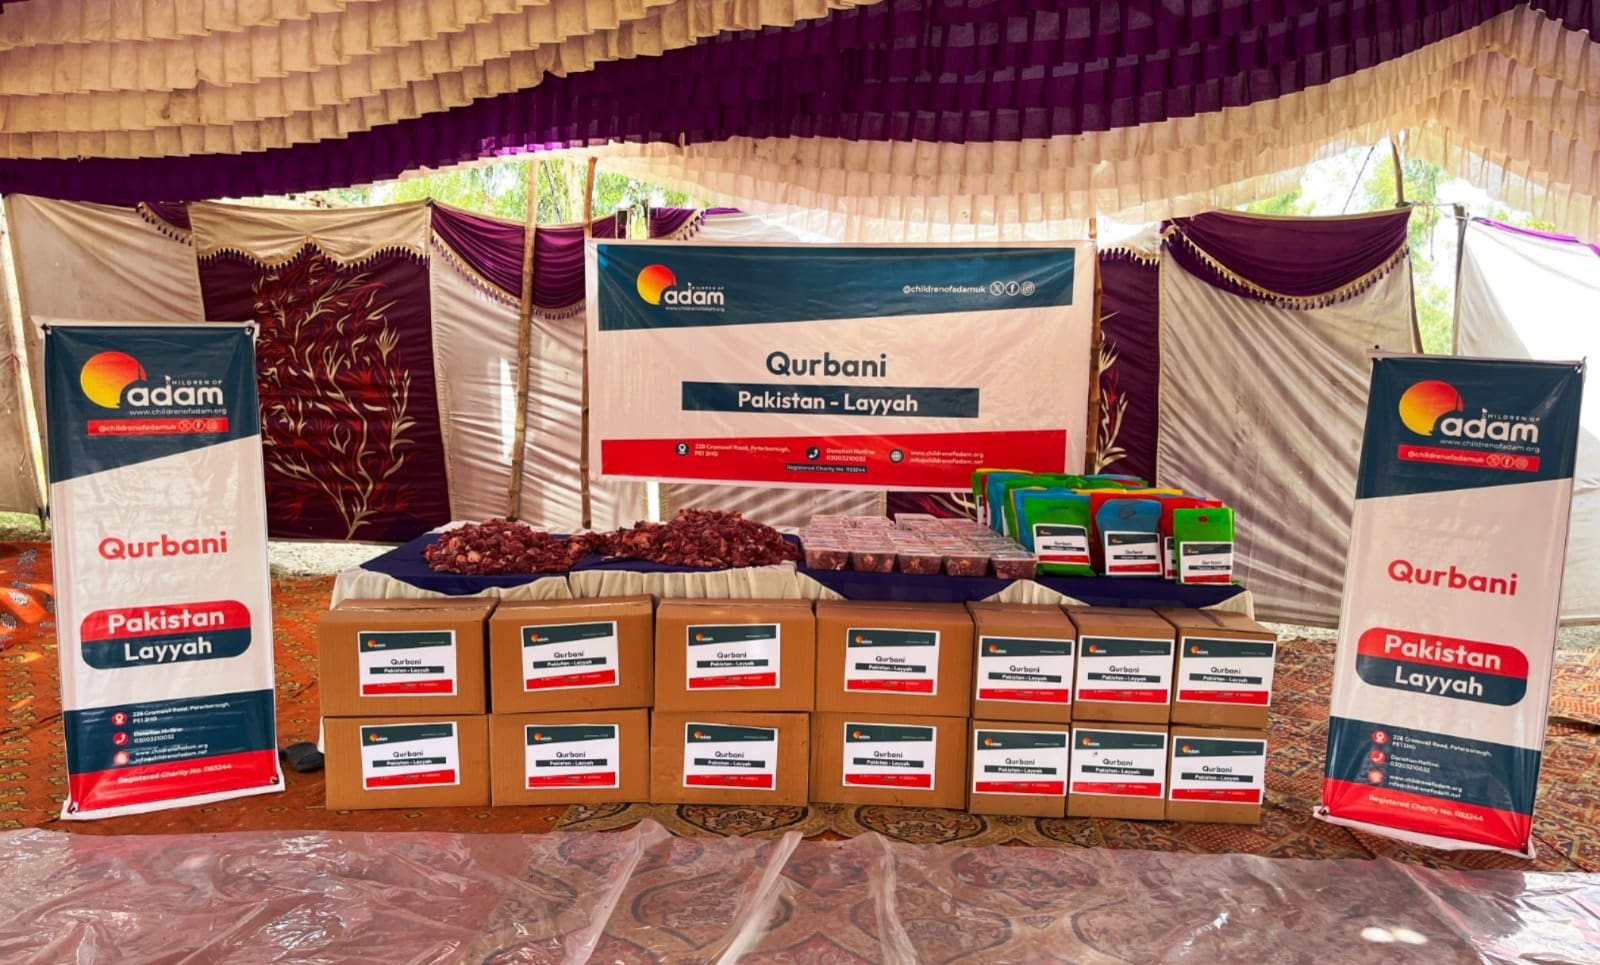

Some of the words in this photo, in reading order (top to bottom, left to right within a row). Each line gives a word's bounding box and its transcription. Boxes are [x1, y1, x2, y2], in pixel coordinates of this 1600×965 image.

[664, 282, 724, 305] adam
[902, 284, 986, 294] @childrenofadamuk
[766, 350, 888, 379] Qurbani
[127, 375, 224, 406] adam
[738, 390, 826, 410] Pakistan
[844, 393, 919, 416] Layyah
[1440, 408, 1539, 442] adam
[1440, 439, 1540, 453] www.childrenofadam.org
[98, 531, 228, 560] Qurbani
[1388, 559, 1518, 596] Qurbani
[108, 610, 225, 634] Pakistan
[124, 637, 212, 662] Layyah
[1384, 634, 1501, 670] Pakistan
[1395, 666, 1484, 696] Layyah
[1411, 804, 1438, 814] Charity
